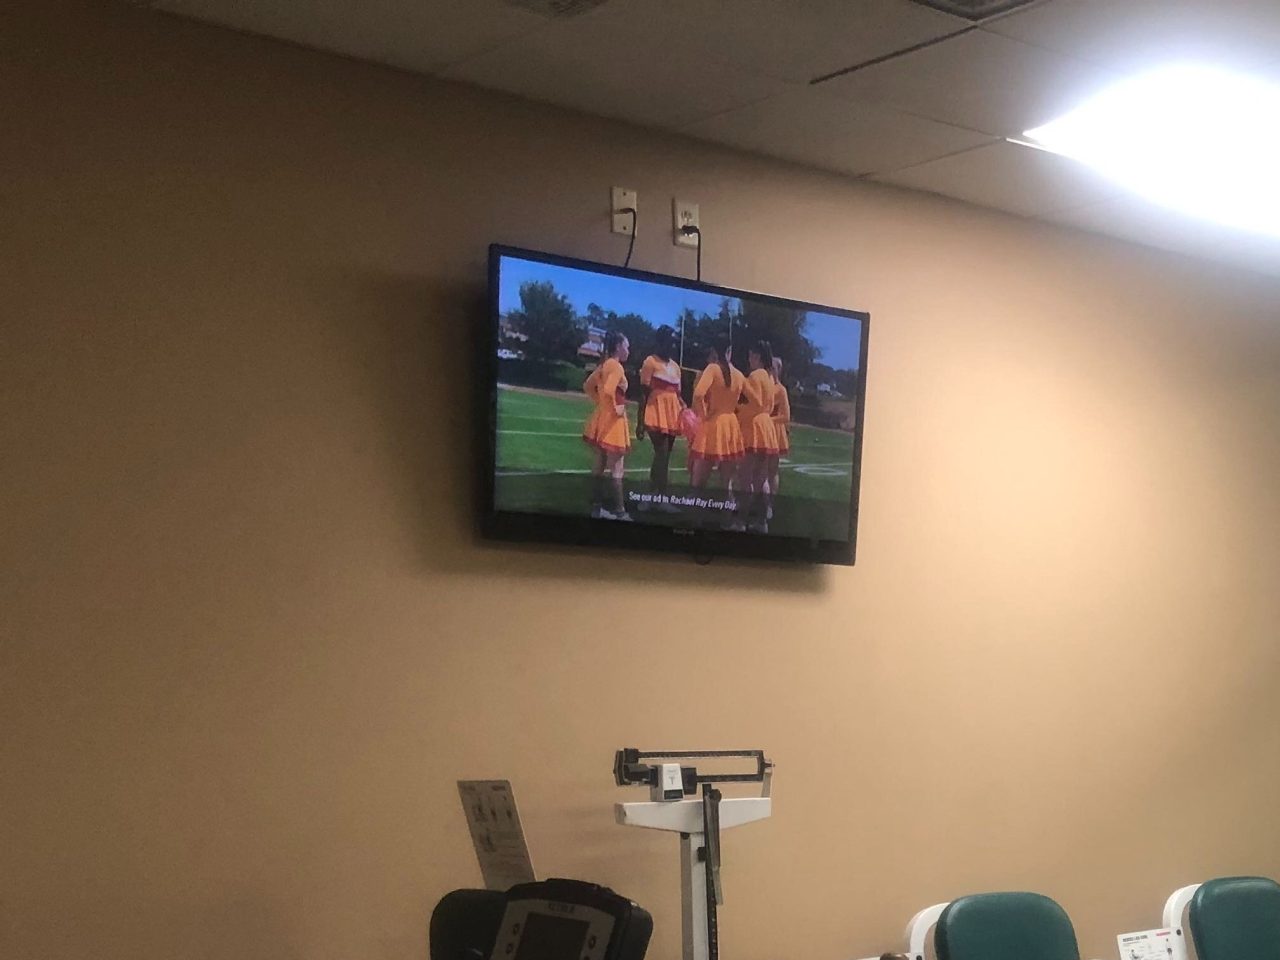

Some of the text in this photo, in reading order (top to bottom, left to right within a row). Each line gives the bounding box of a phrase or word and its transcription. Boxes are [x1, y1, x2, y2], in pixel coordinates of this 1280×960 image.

[629, 491, 641, 501] See
[670, 495, 695, 506] Rachael
[696, 497, 707, 509] Ray
[708, 499, 724, 510] Every
